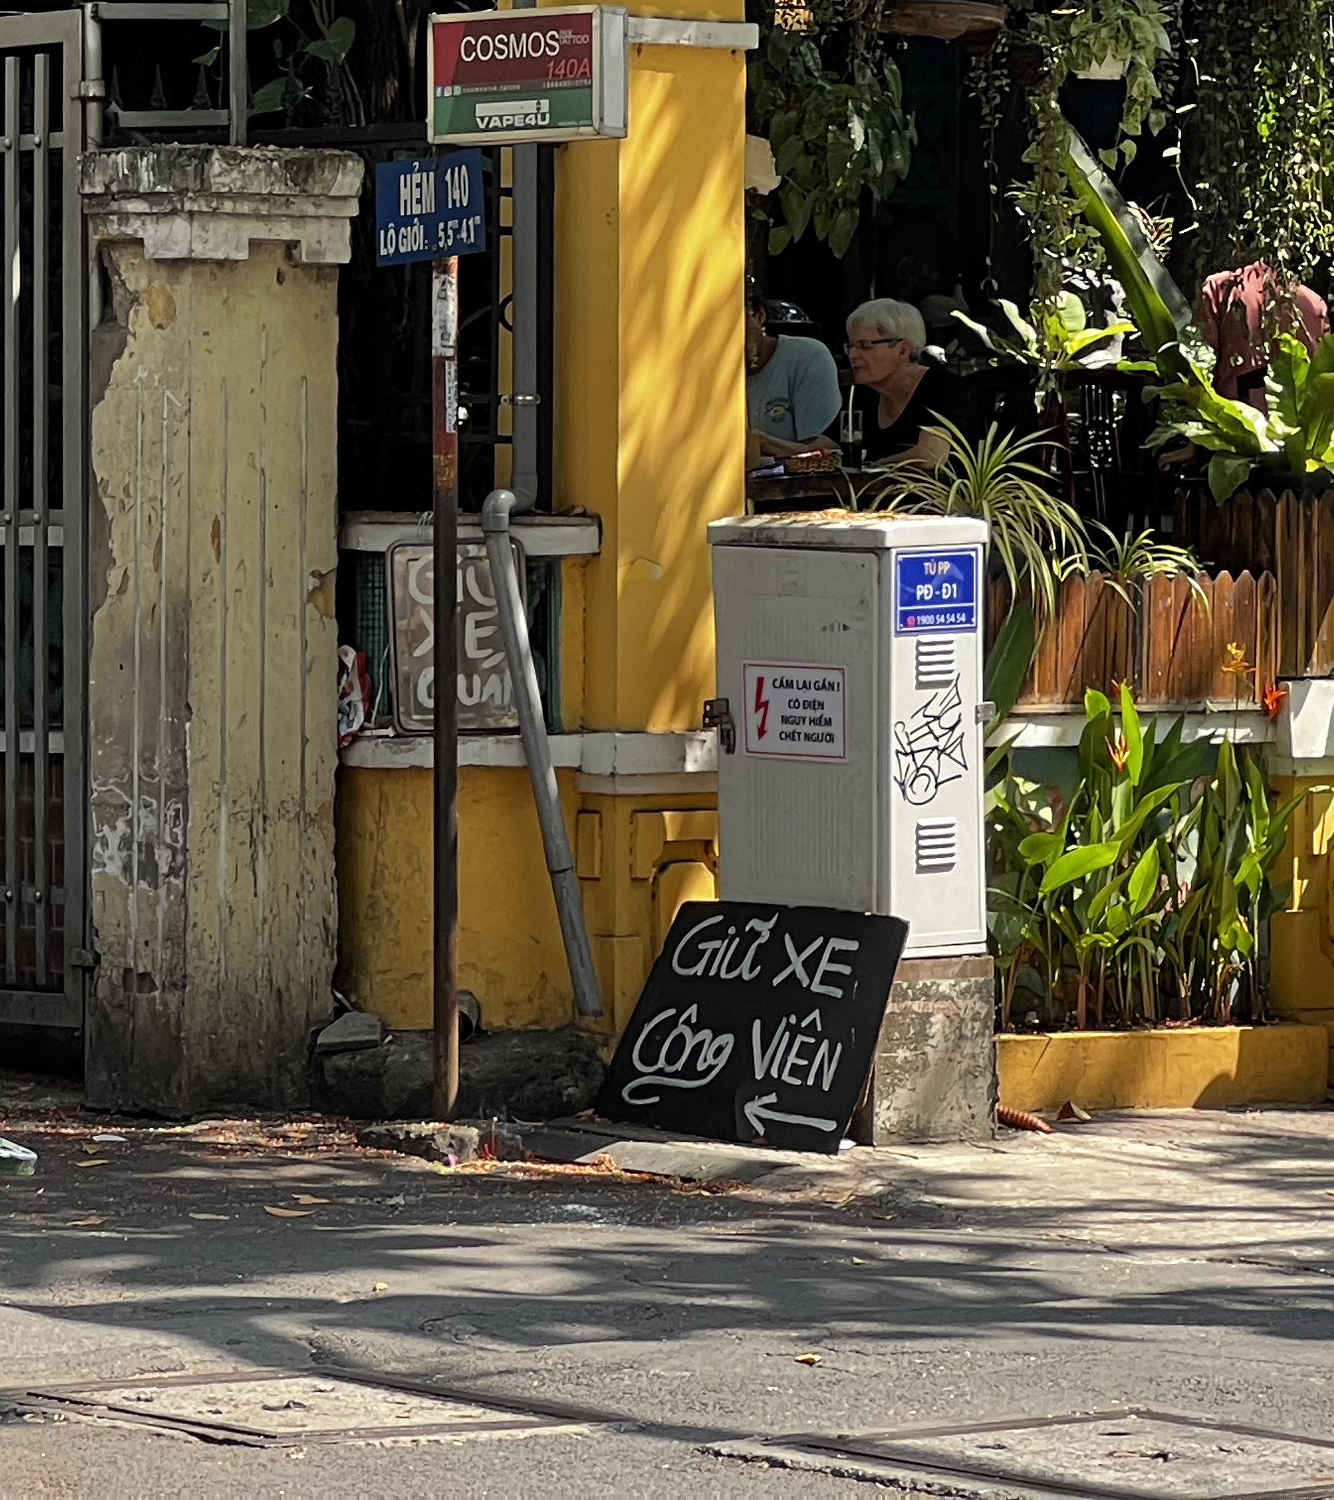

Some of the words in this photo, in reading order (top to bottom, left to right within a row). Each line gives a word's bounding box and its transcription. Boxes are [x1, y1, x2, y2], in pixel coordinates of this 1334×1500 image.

[460, 30, 560, 62] COSMOS
[547, 58, 590, 79] 140A
[476, 113, 549, 129] VAPE4U
[399, 161, 435, 216] HẺM
[445, 164, 469, 209] 140
[380, 222, 396, 257] LỘ
[938, 561, 950, 575] PP
[917, 615, 934, 625] 1900
[936, 614, 945, 624] 54
[946, 613, 955, 624] 54
[956, 612, 966, 623] 54
[796, 679, 812, 693] LẠI
[788, 697, 800, 710] CÓ
[781, 715, 807, 726] NGUY
[771, 932, 860, 999] XE
